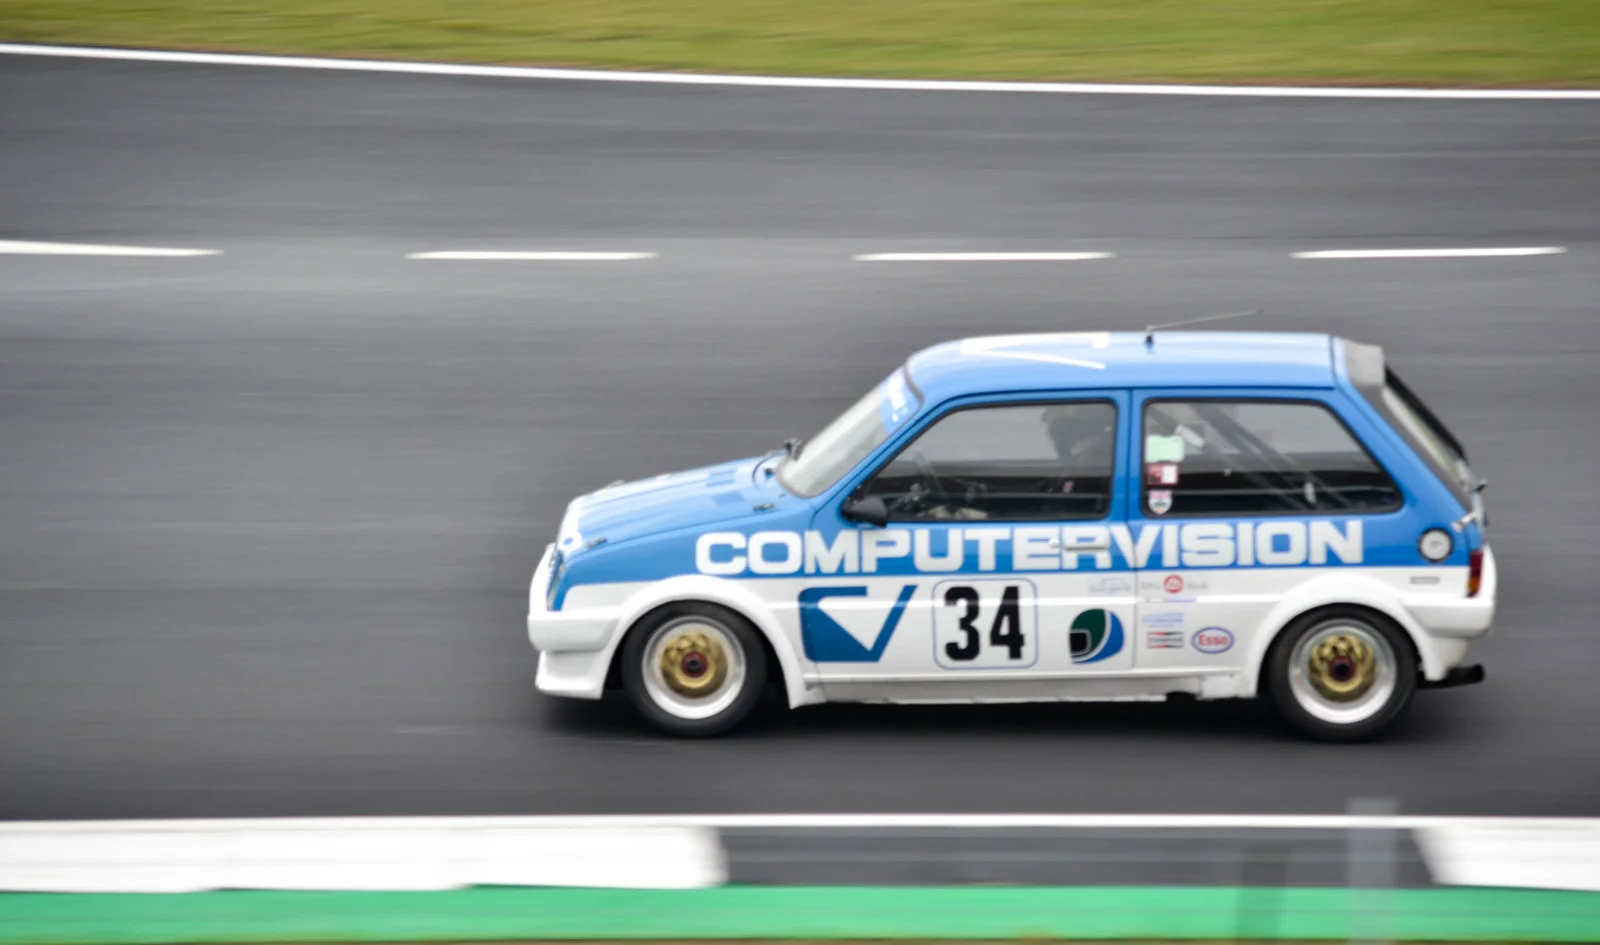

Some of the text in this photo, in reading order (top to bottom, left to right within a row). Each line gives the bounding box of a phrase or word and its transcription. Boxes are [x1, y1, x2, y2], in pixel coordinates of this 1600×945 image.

[695, 520, 1363, 575] COMPUTERVISION
[944, 586, 1025, 661] 34
[1197, 634, 1229, 646] Esso
